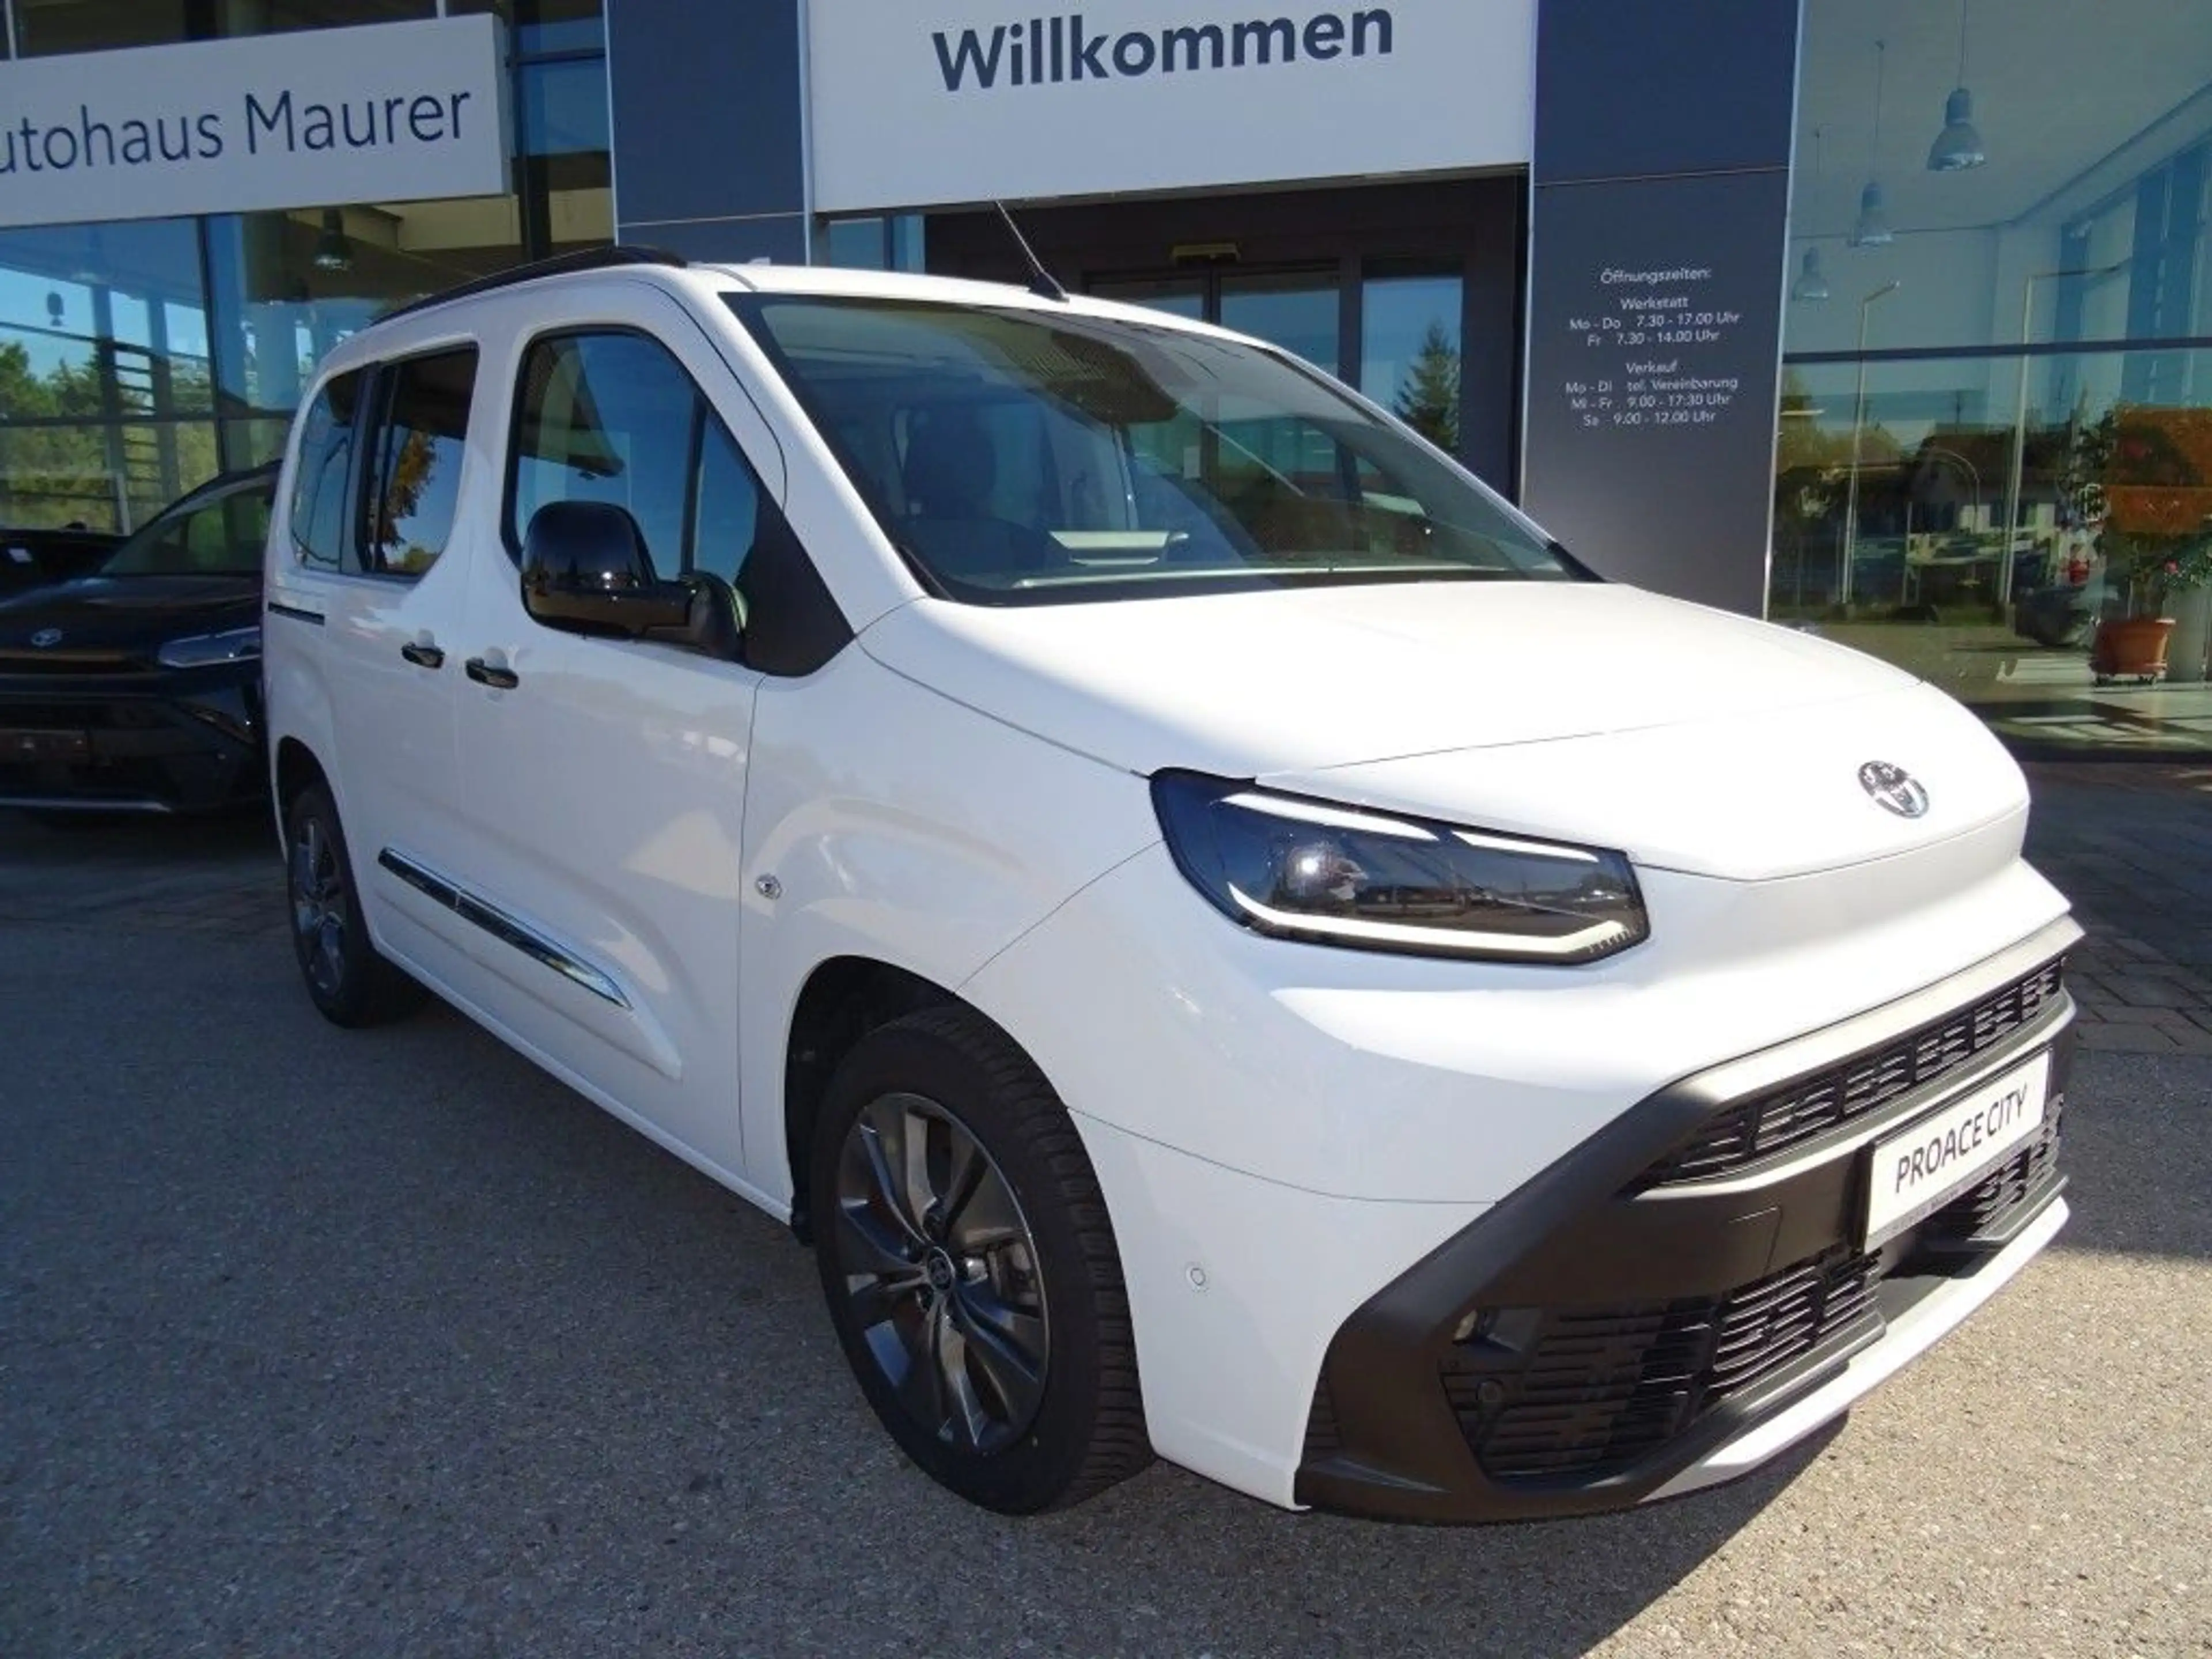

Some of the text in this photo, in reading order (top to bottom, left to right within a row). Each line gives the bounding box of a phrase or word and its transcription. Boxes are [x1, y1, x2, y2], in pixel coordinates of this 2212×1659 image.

[931, 8, 1393, 91] Willkommen
[245, 90, 470, 154] Maurer
[1600, 267, 1712, 285] Öffnungszeiten:
[1620, 297, 1689, 309] Werkstatt
[1569, 318, 1590, 330] Mo
[1602, 317, 1621, 329] Do
[1717, 312, 1740, 324] Uhr
[1588, 334, 1601, 346] Fr
[1617, 332, 1645, 345] 7.30
[1657, 331, 1692, 343] 14.00
[1695, 329, 1720, 342] Uhr
[1625, 360, 1677, 374] Verkauf
[1566, 381, 1586, 393] Mo
[1650, 378, 1738, 392] Vereinbarung
[1599, 396, 1612, 408] Fr
[1706, 393, 1731, 405] Uhr
[1694, 410, 1717, 422] Uhr
[1895, 1083, 2028, 1194] PROACE CITY
